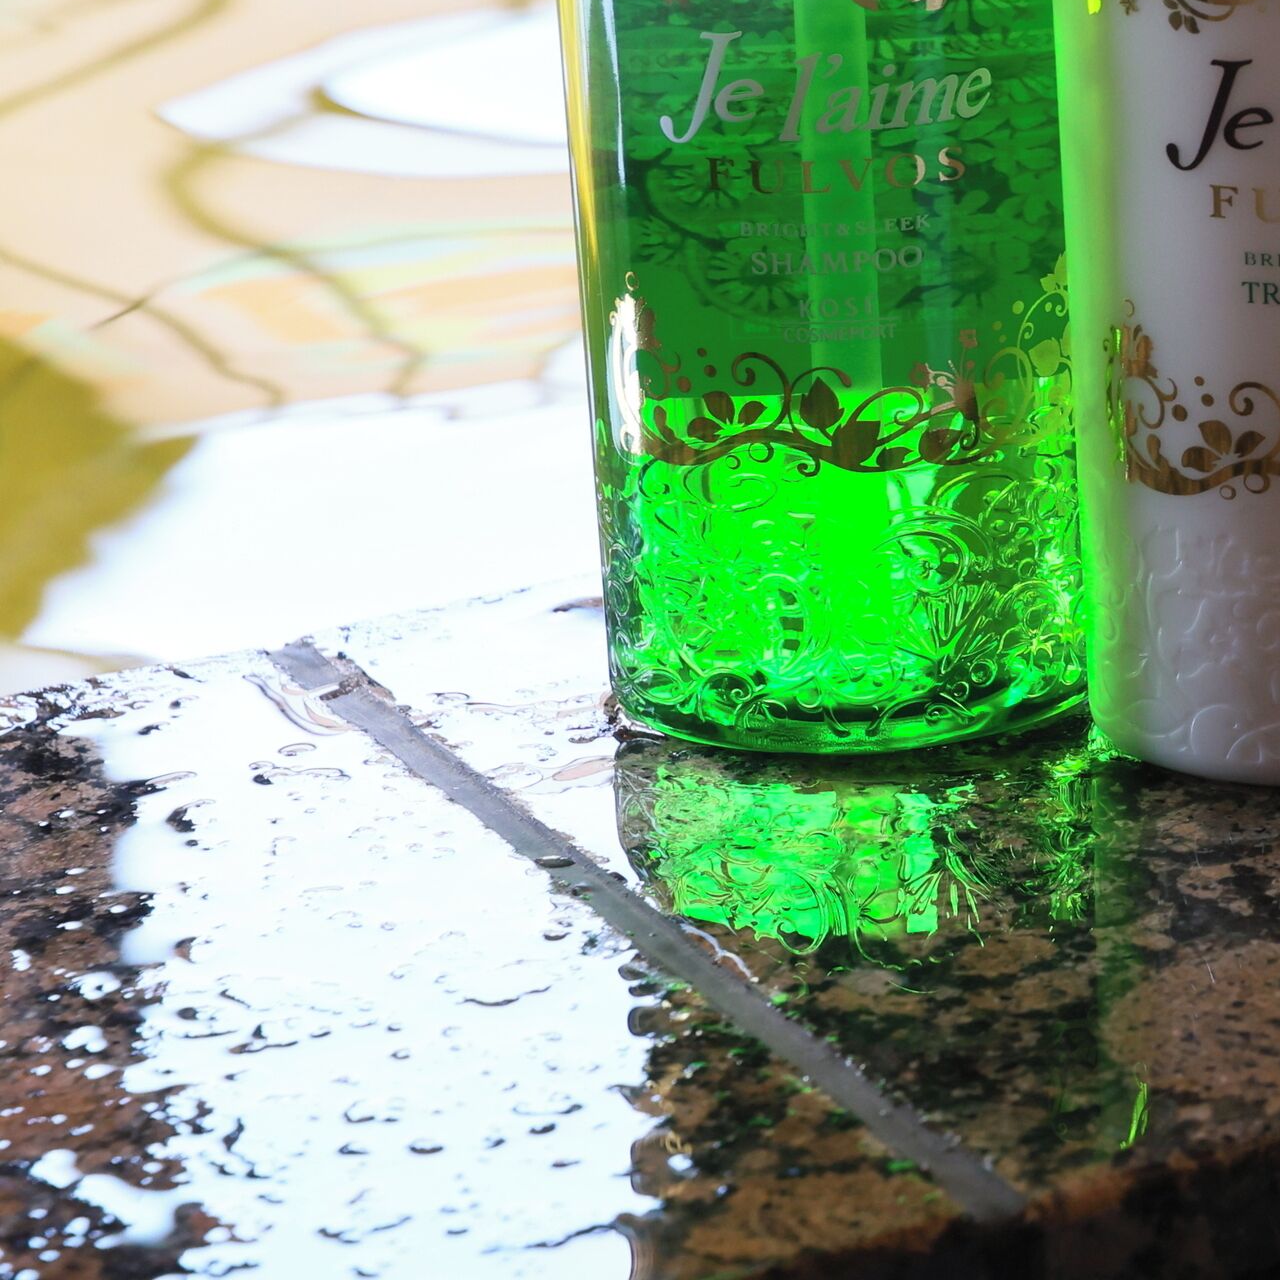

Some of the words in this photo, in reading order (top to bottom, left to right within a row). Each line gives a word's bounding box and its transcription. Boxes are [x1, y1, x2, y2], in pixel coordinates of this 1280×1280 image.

[658, 31, 763, 144] Je
[779, 53, 992, 144] l'aime
[1165, 59, 1274, 171] Je
[706, 146, 967, 195] FULVOS
[751, 245, 924, 276] SHAMPOO
